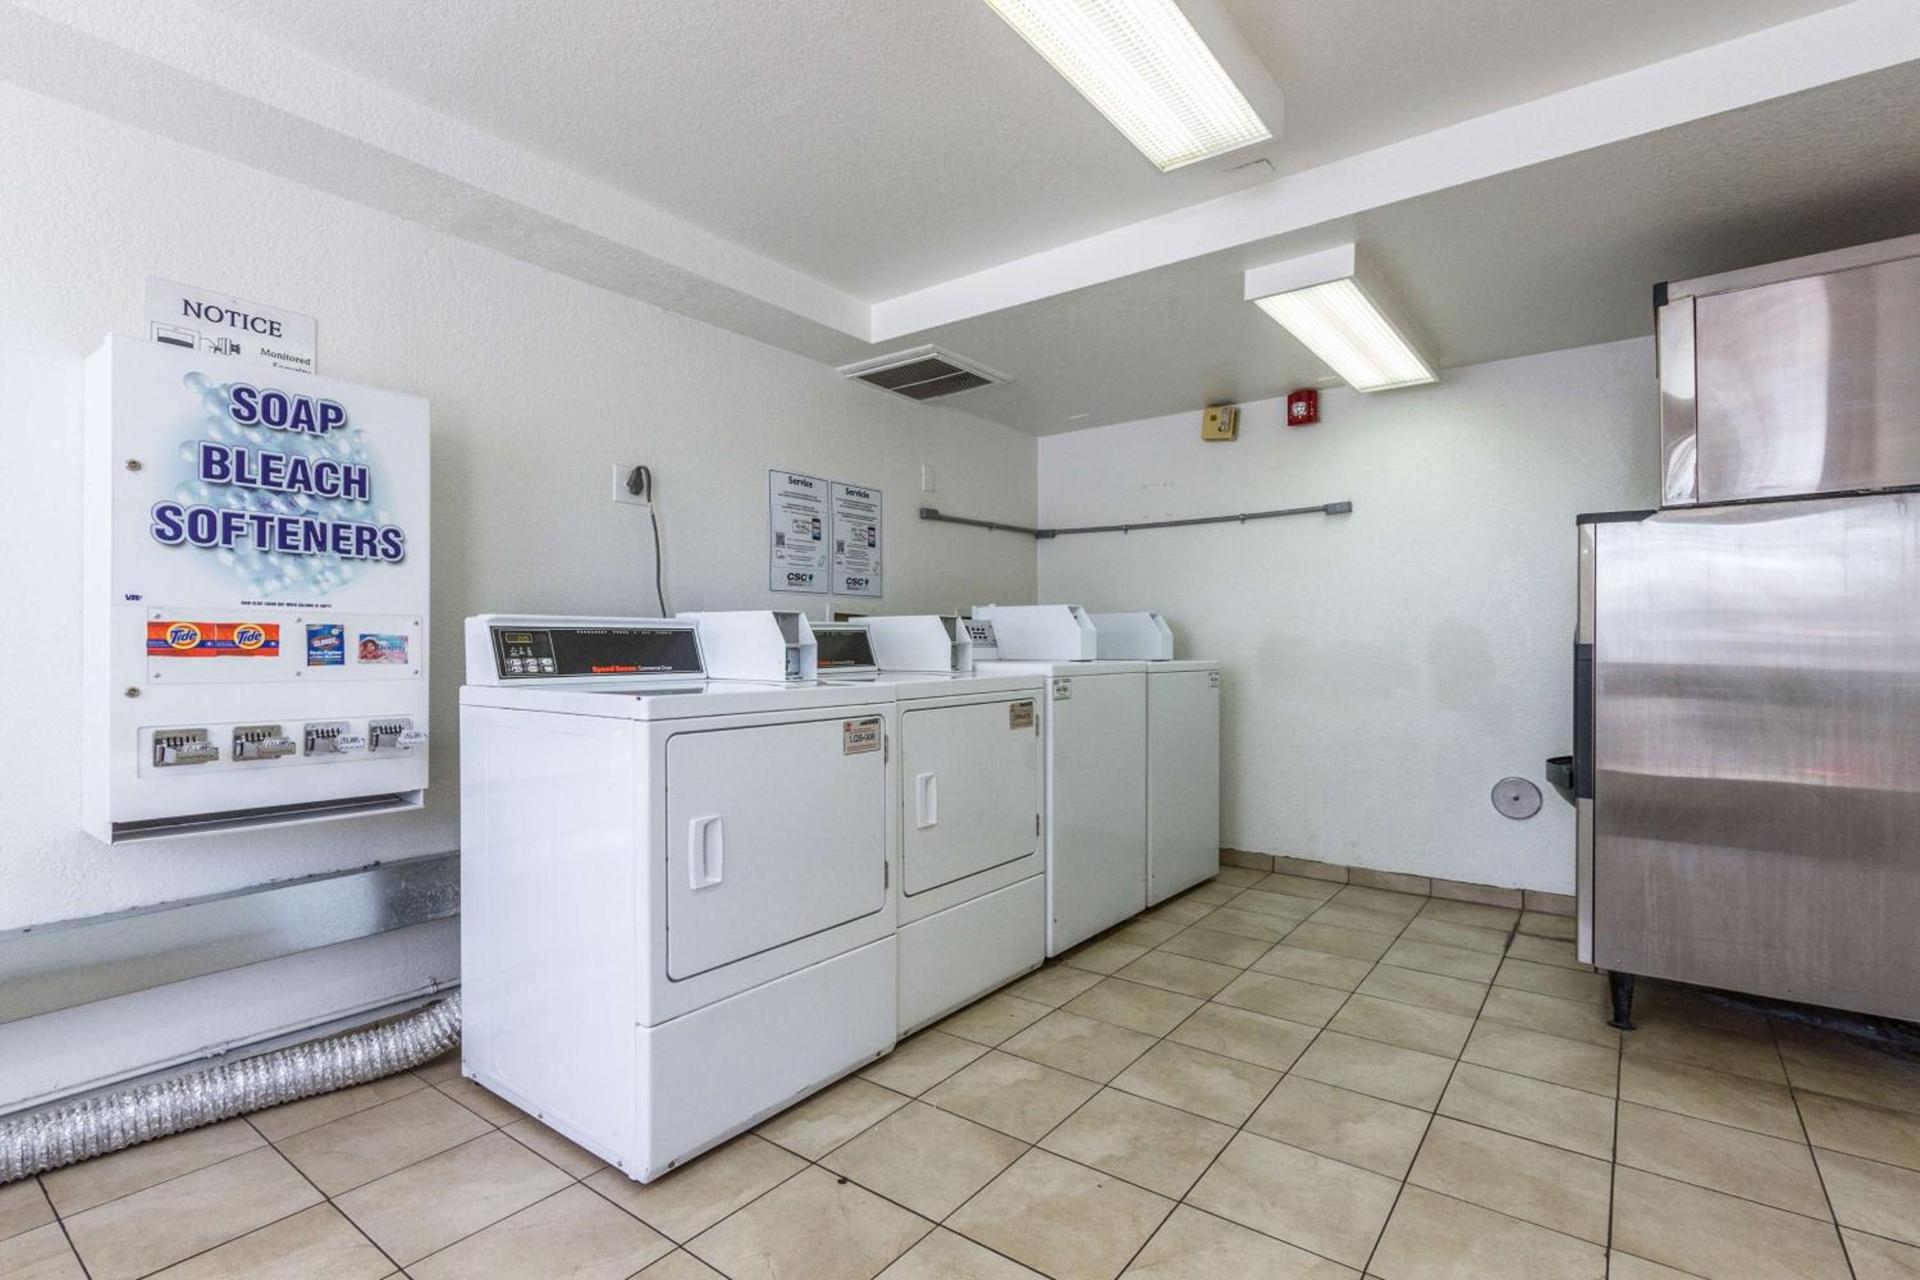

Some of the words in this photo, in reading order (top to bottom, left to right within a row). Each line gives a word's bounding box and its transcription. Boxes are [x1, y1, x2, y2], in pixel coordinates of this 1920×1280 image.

[181, 298, 283, 339] NOTICE
[260, 347, 311, 366] Monitored
[229, 383, 347, 435] SOAP
[199, 441, 370, 500] BLEACH
[788, 475, 813, 488] Service
[845, 487, 870, 500] Servicio
[151, 501, 405, 562] SOFTENERS
[787, 572, 807, 581] CSC
[846, 577, 864, 586] CSC
[170, 629, 198, 644] Tide
[237, 630, 262, 644] Tide
